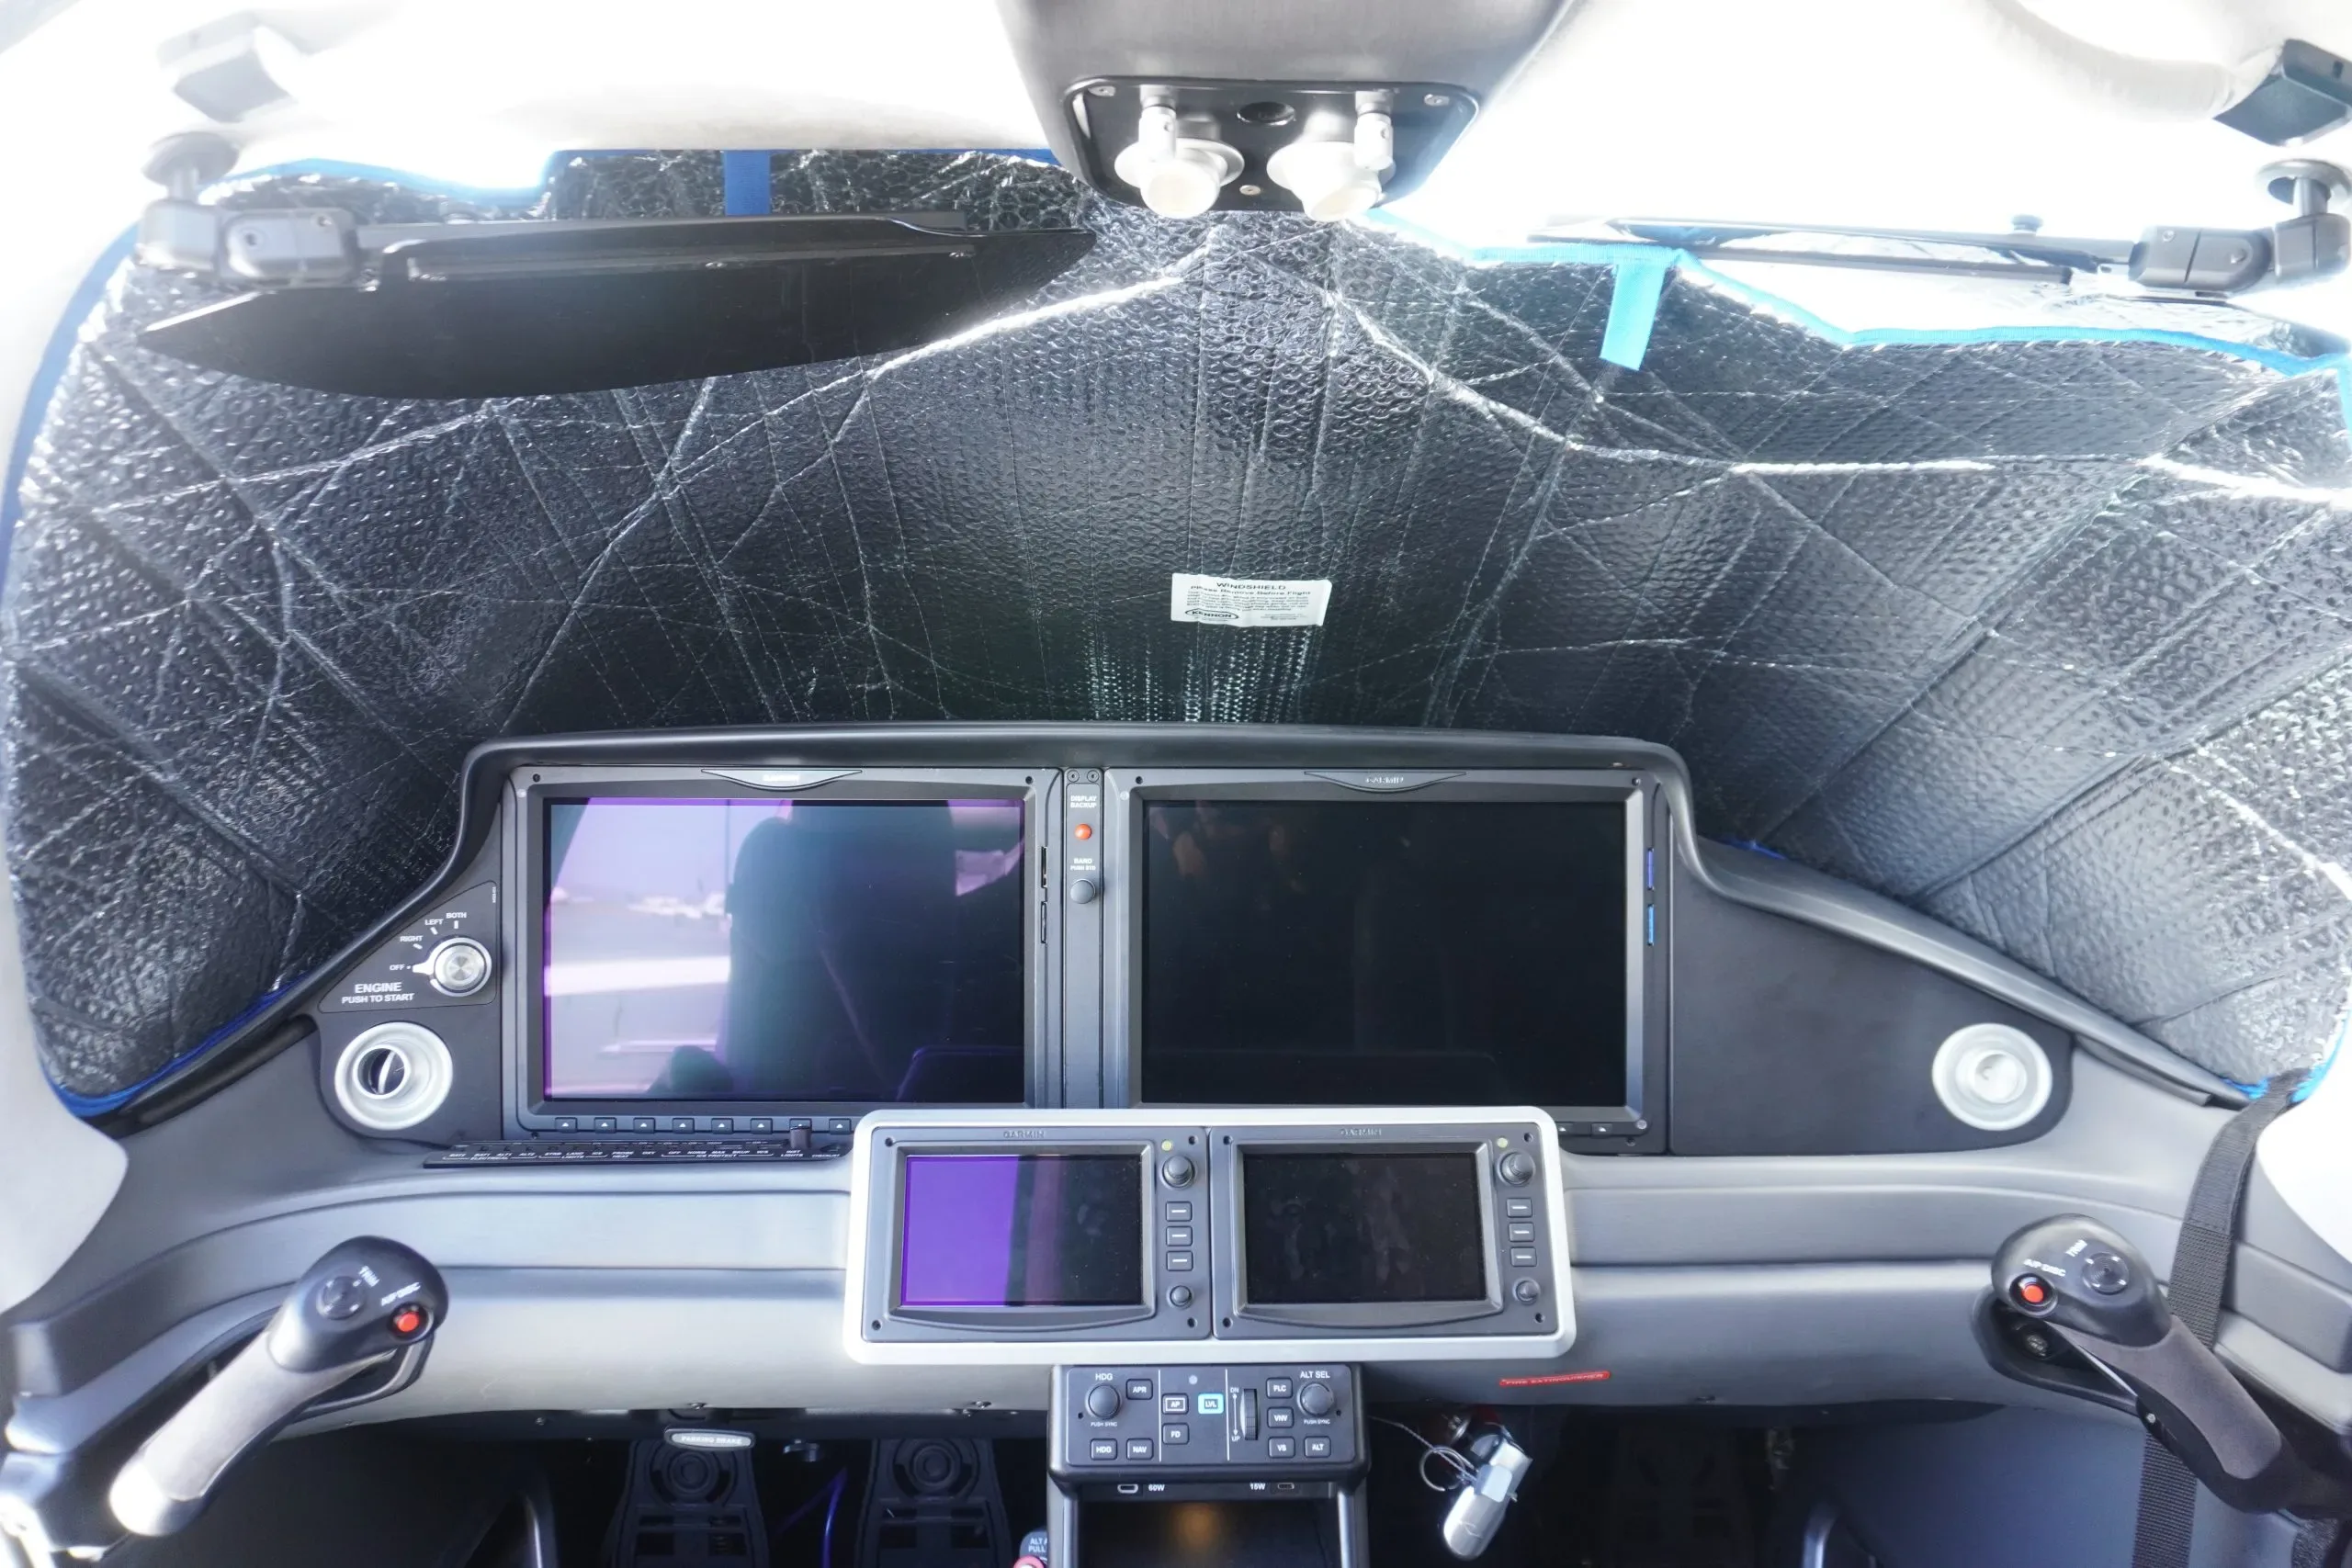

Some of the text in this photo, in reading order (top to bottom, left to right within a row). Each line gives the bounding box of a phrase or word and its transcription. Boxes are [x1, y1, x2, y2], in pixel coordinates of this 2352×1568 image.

[1192, 610, 1232, 618] KENNON
[355, 982, 402, 994] ENGINE
[342, 993, 414, 1004] PUSH TO START
[1095, 1372, 1114, 1381] HDG
[1315, 1371, 1331, 1379] SEL
[1273, 1384, 1287, 1393] FLC
[1204, 1400, 1217, 1408] LVL
[1170, 1430, 1182, 1438] FD
[1276, 1443, 1287, 1452] VS
[1148, 1483, 1165, 1492] 60W
[1030, 1537, 1044, 1545] ALT
